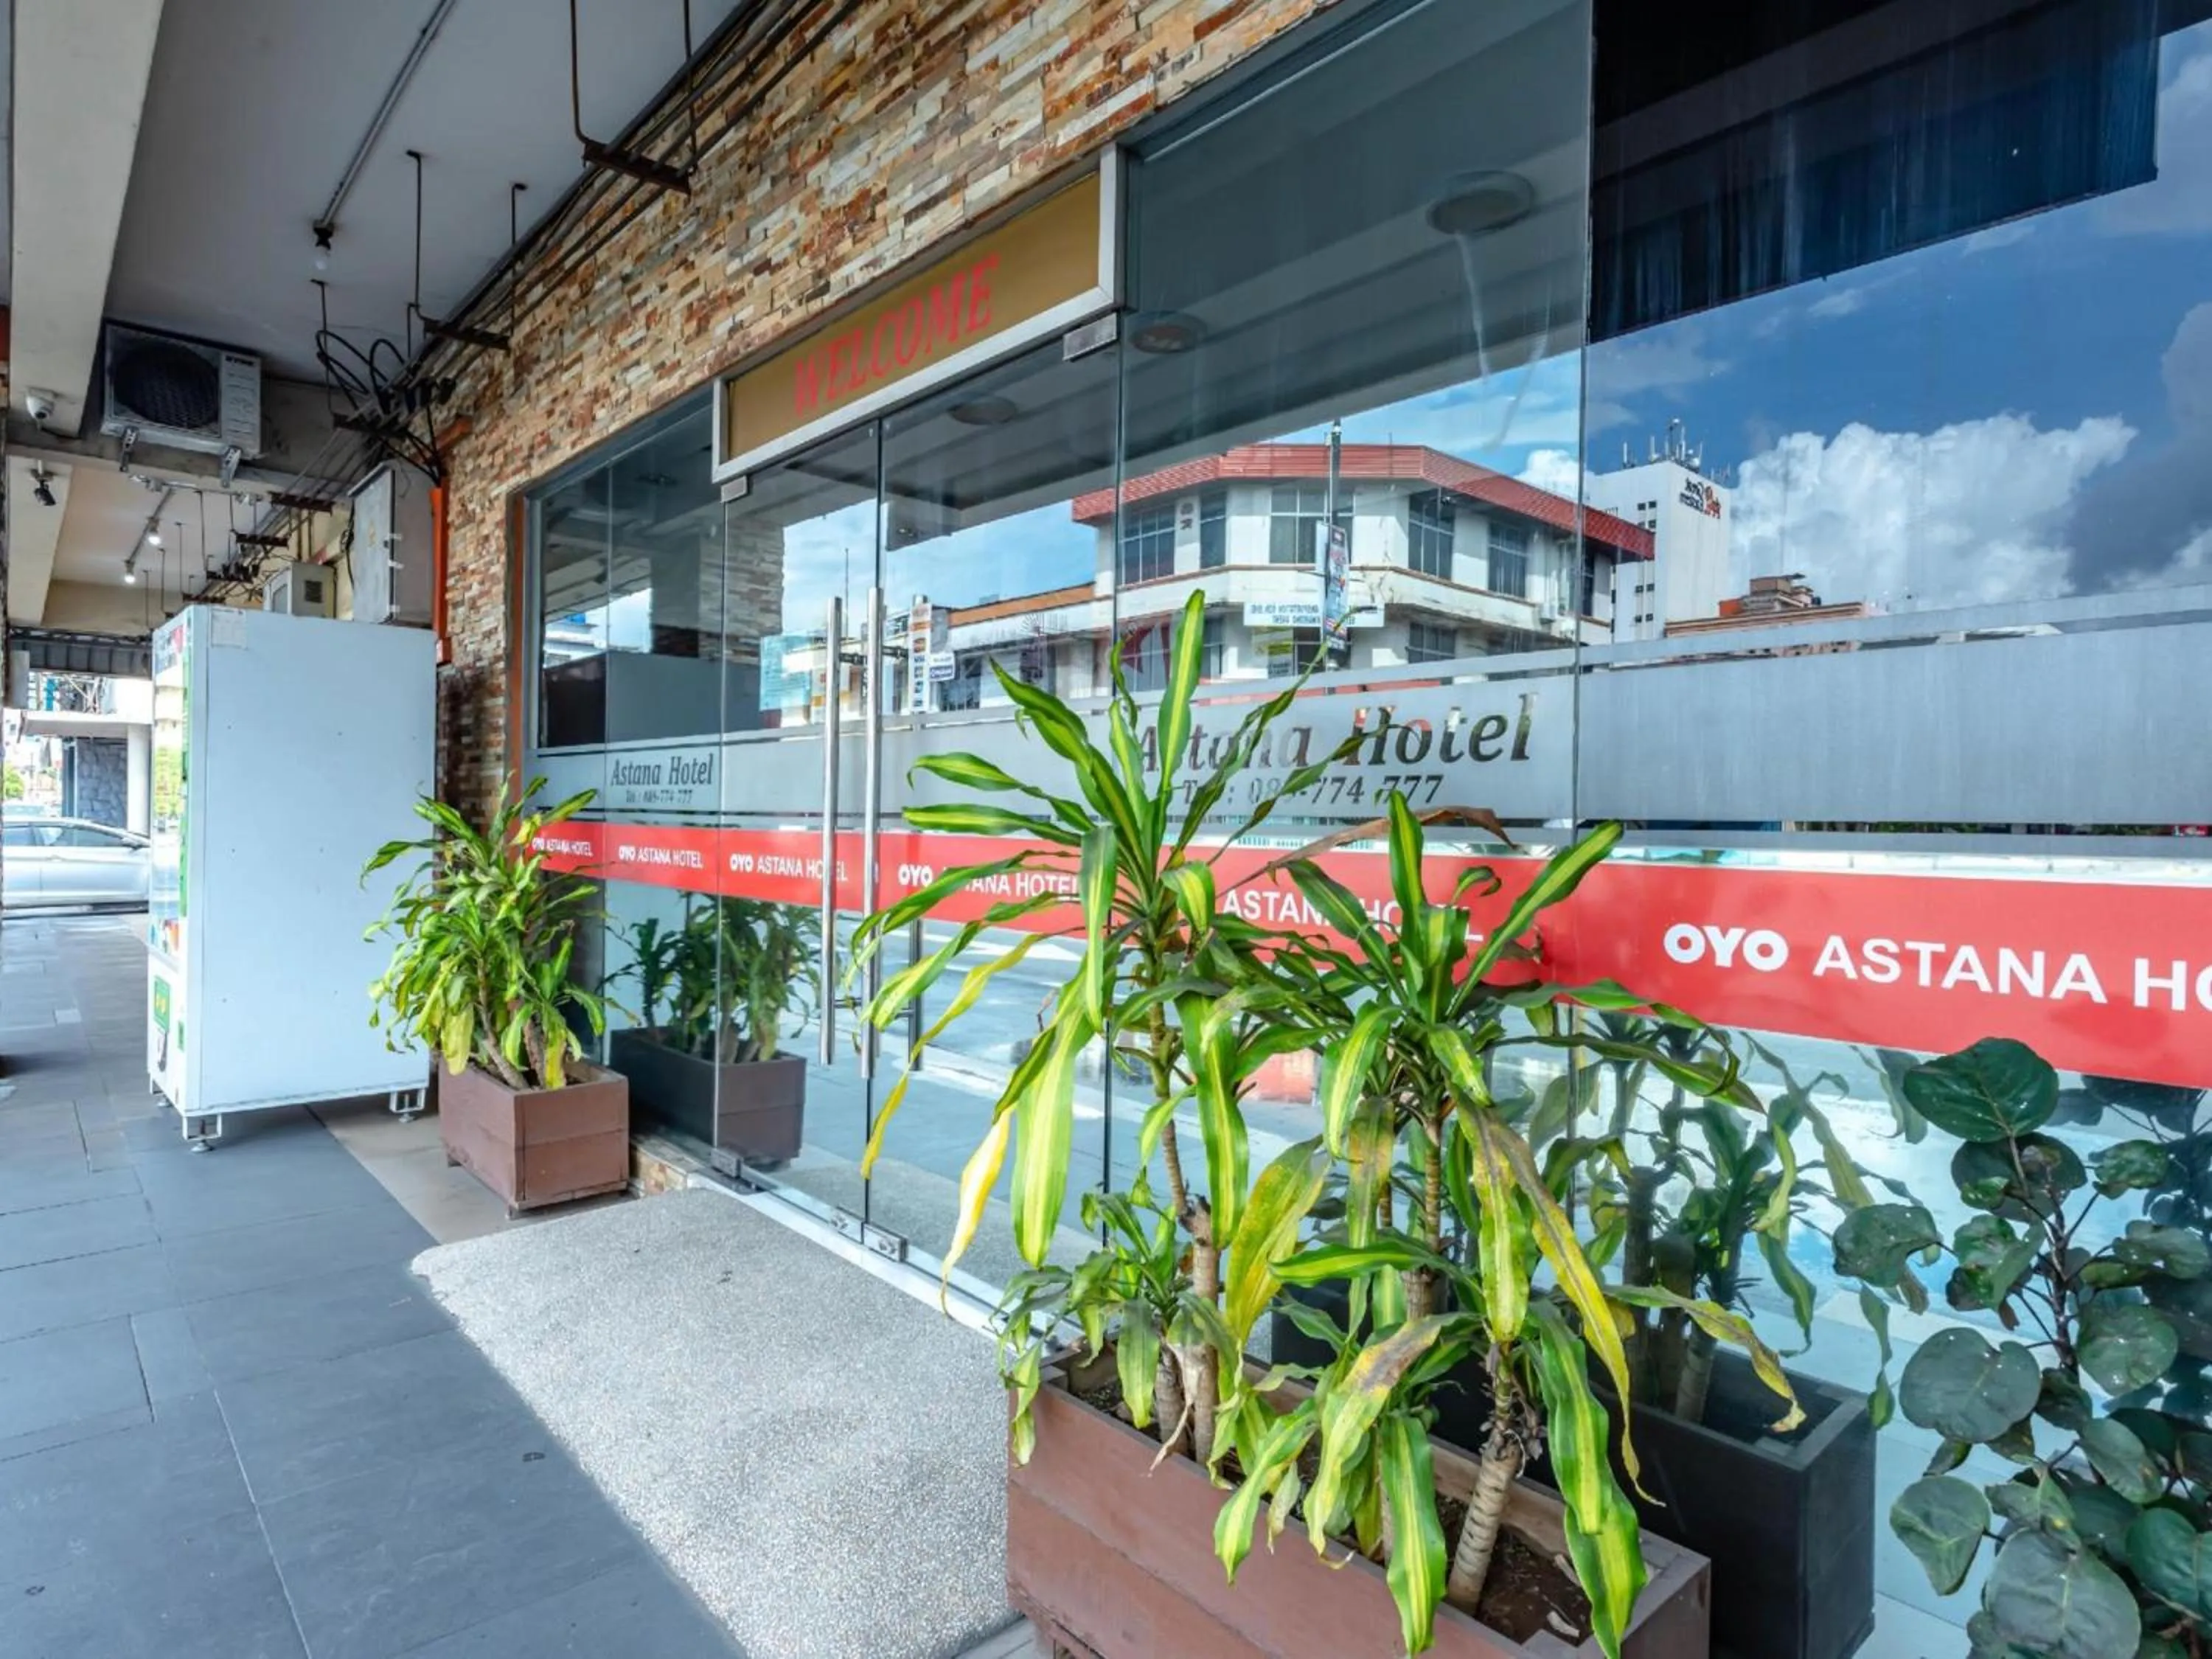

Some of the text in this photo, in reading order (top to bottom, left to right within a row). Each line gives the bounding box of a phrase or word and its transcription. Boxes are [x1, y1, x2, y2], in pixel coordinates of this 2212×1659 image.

[793, 251, 1001, 417] WELCOME
[1140, 692, 1539, 772] Atana Hotel
[611, 753, 714, 786] Astana Hotel
[1382, 775, 1444, 804] 777
[569, 841, 594, 858] HOTEL
[618, 845, 703, 869] OYO ASTANA HOTEL
[729, 853, 847, 882] OYO ASTANA HOEL
[897, 863, 933, 888] OYO
[1222, 889, 1331, 927] ASTAN
[1663, 923, 1789, 971] OYO
[1813, 934, 2107, 1004] ASTANA
